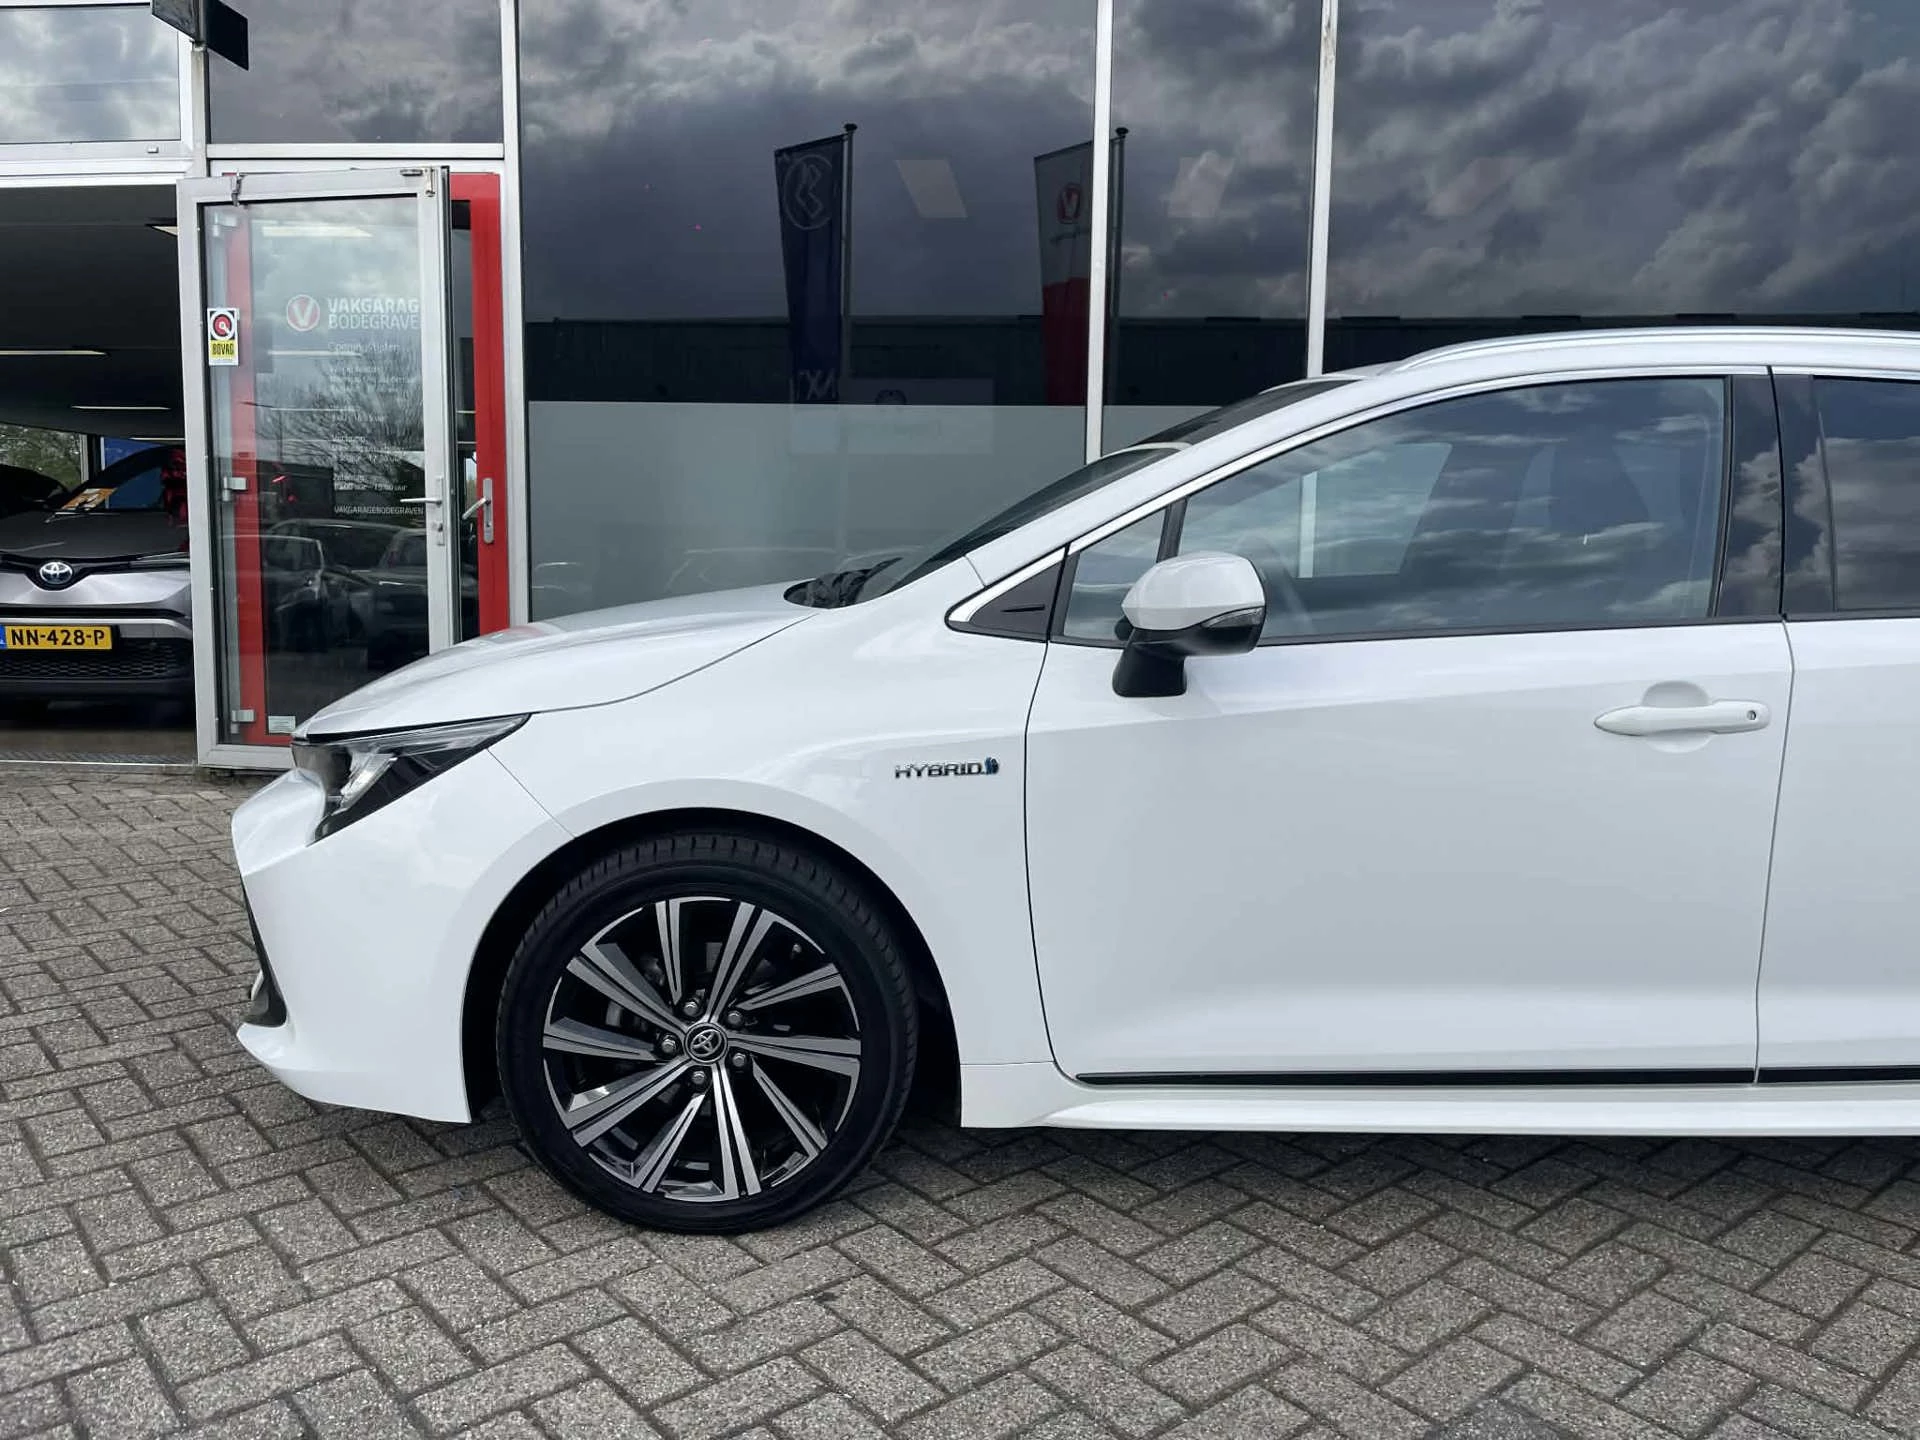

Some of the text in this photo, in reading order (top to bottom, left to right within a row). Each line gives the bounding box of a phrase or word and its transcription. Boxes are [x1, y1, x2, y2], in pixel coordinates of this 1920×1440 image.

[212, 343, 235, 356] BOVAG
[11, 628, 106, 646] NN-428-P
[894, 761, 982, 779] HYBRID
